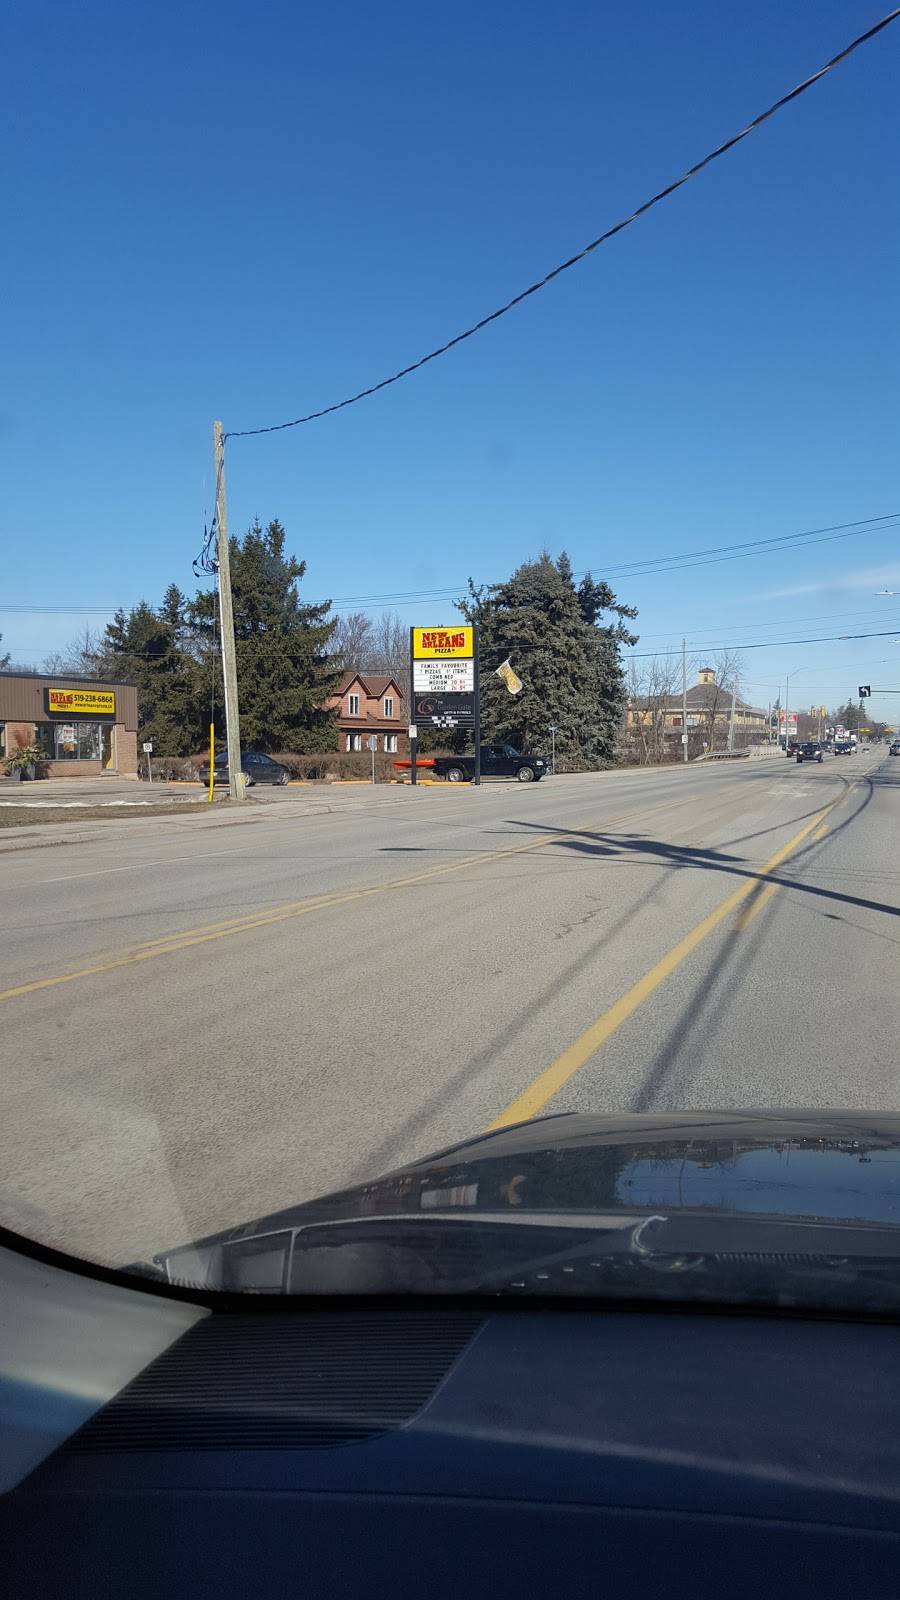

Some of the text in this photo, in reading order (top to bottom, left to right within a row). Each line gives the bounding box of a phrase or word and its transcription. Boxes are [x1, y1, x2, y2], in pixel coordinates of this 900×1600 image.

[422, 632, 447, 641] NEW
[422, 632, 465, 648] ORLEANS
[74, 694, 113, 703] 519-238-6868
